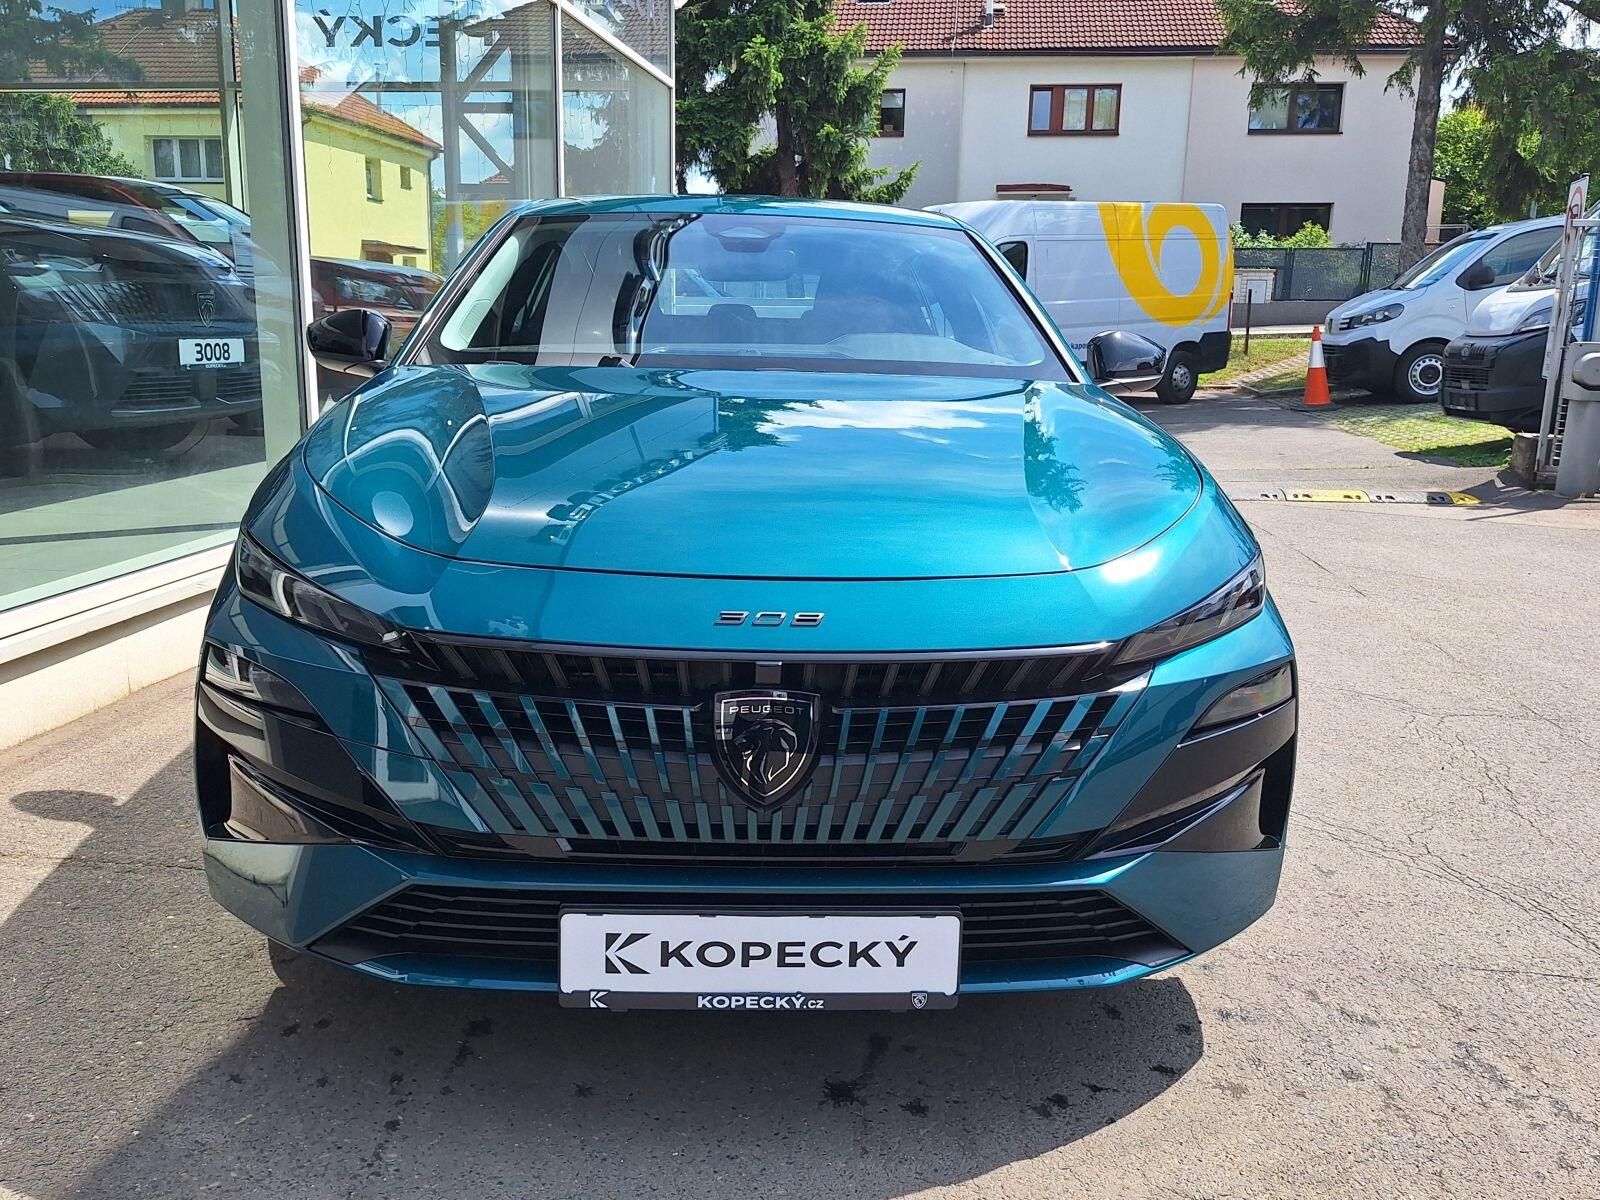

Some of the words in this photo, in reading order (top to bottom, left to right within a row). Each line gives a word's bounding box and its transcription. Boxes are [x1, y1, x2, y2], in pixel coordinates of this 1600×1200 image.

[194, 342, 231, 362] 3008
[713, 610, 825, 627] 308
[729, 705, 804, 714] PEUGEOT
[659, 934, 919, 968] KOPECKÝ
[697, 993, 825, 1009] KOPECKÝ.cz
